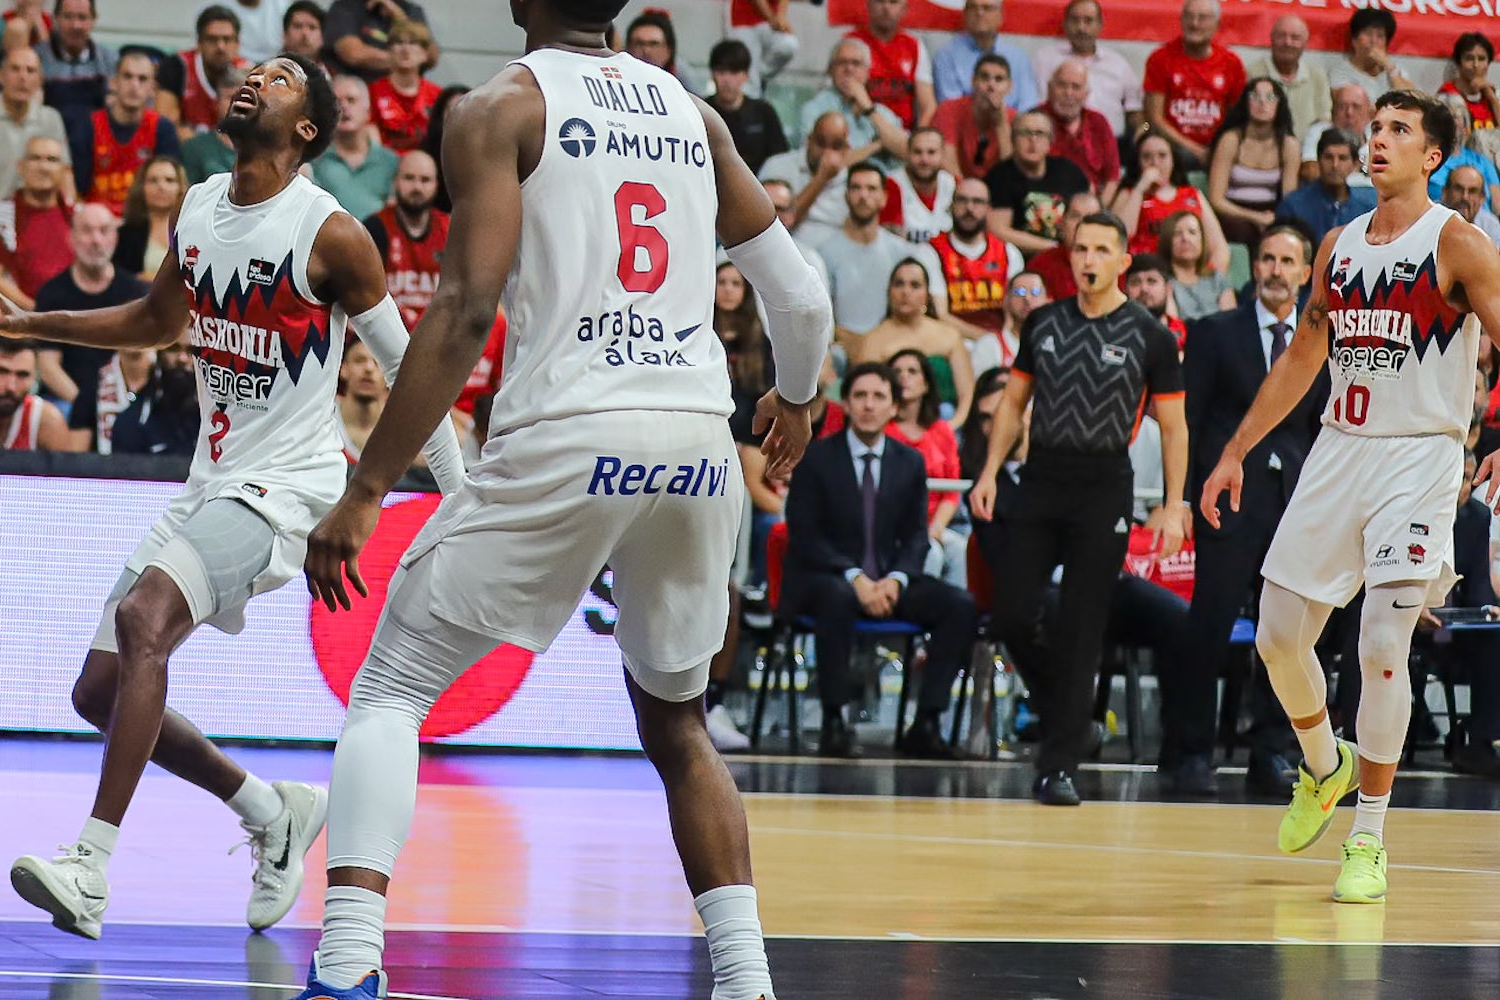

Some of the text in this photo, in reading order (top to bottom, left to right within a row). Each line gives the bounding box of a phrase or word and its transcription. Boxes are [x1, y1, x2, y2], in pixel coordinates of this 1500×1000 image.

[582, 75, 668, 116] DIALLO
[606, 130, 706, 168] AMUTIO
[614, 180, 669, 294] 6
[577, 304, 664, 342] araba
[605, 339, 697, 367] álava
[208, 410, 231, 464] 2
[587, 455, 729, 497] Recalvi
